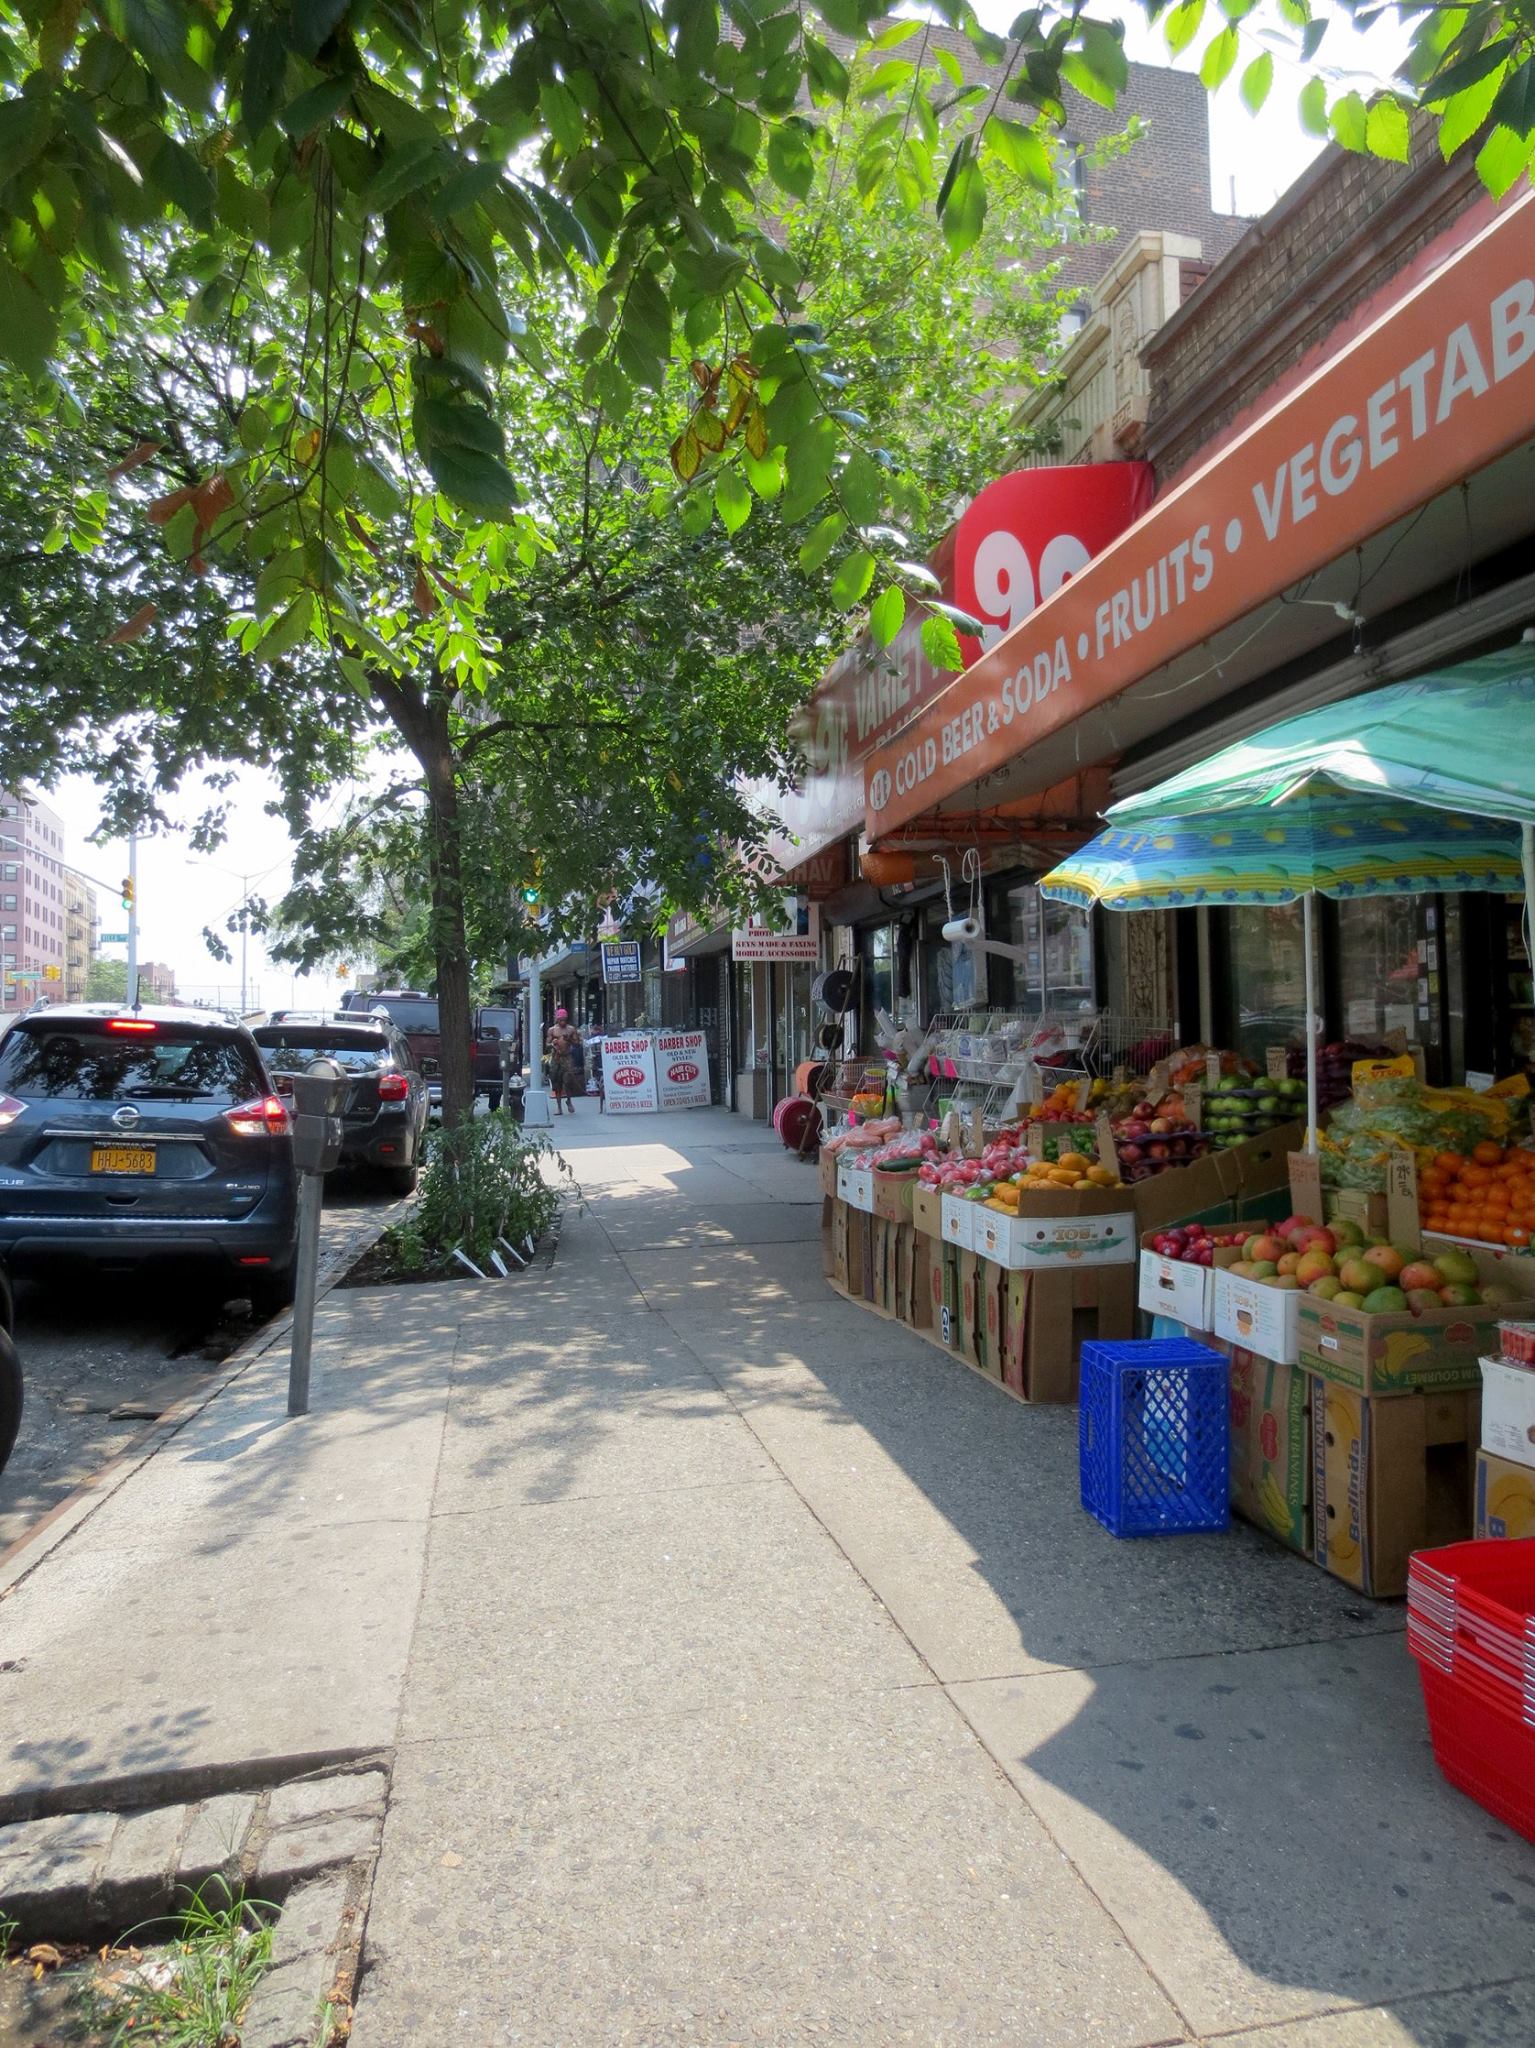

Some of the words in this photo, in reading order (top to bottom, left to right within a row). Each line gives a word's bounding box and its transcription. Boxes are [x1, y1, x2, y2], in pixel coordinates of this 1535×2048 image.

[895, 737, 936, 795] COLD
[942, 703, 985, 767] BEER
[987, 703, 1001, 733] &
[1001, 637, 1072, 725] SODA
[1095, 525, 1214, 660] FRUITS
[1252, 278, 1535, 541] VEGETAB
[605, 1041, 630, 1054] BARBER
[632, 1040, 648, 1052] SHOP
[659, 1038, 684, 1050] BARBER
[686, 1035, 702, 1048] SHOP
[615, 1069, 630, 1080] HAIR
[630, 1069, 643, 1079] CUT
[670, 1065, 684, 1077] HAIR
[684, 1065, 697, 1075] CUT
[623, 1077, 636, 1085] $11
[1403, 1369, 1460, 1385] GOURMET
[1290, 1378, 1301, 1440] PREMIUM
[1315, 1388, 1325, 1468] BANANAS
[1290, 1441, 1300, 1505] BANANAS
[1316, 1472, 1327, 1553] PREMIUM
